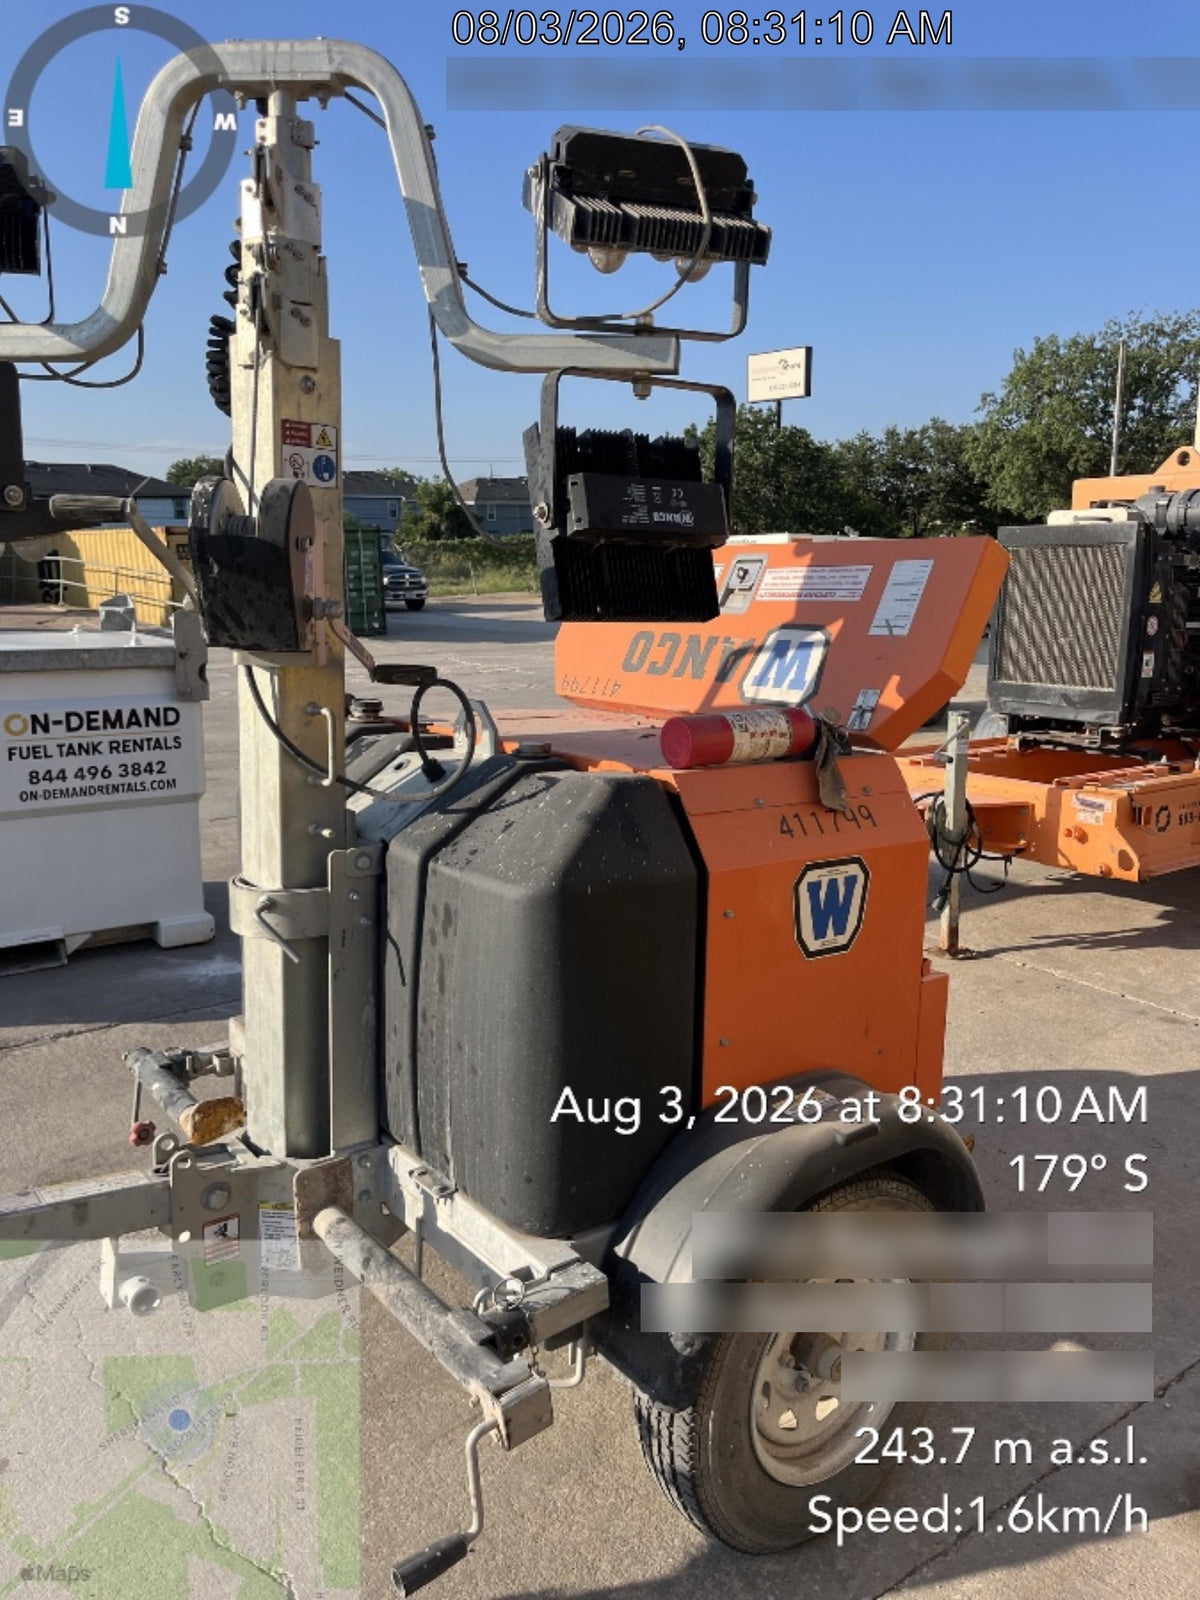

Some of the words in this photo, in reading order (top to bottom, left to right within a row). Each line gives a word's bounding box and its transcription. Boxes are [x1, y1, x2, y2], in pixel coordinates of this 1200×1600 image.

[3, 706, 181, 737] ON-DEMAND
[8, 745, 53, 762] FUEL
[57, 741, 103, 758] TANK
[109, 736, 182, 755] RENTALS
[29, 768, 67, 785] 844
[74, 764, 112, 781] 496
[119, 760, 167, 778] 3842
[19, 778, 177, 802] ON-DEMANDRENTALS.COM
[806, 873, 859, 942] W
